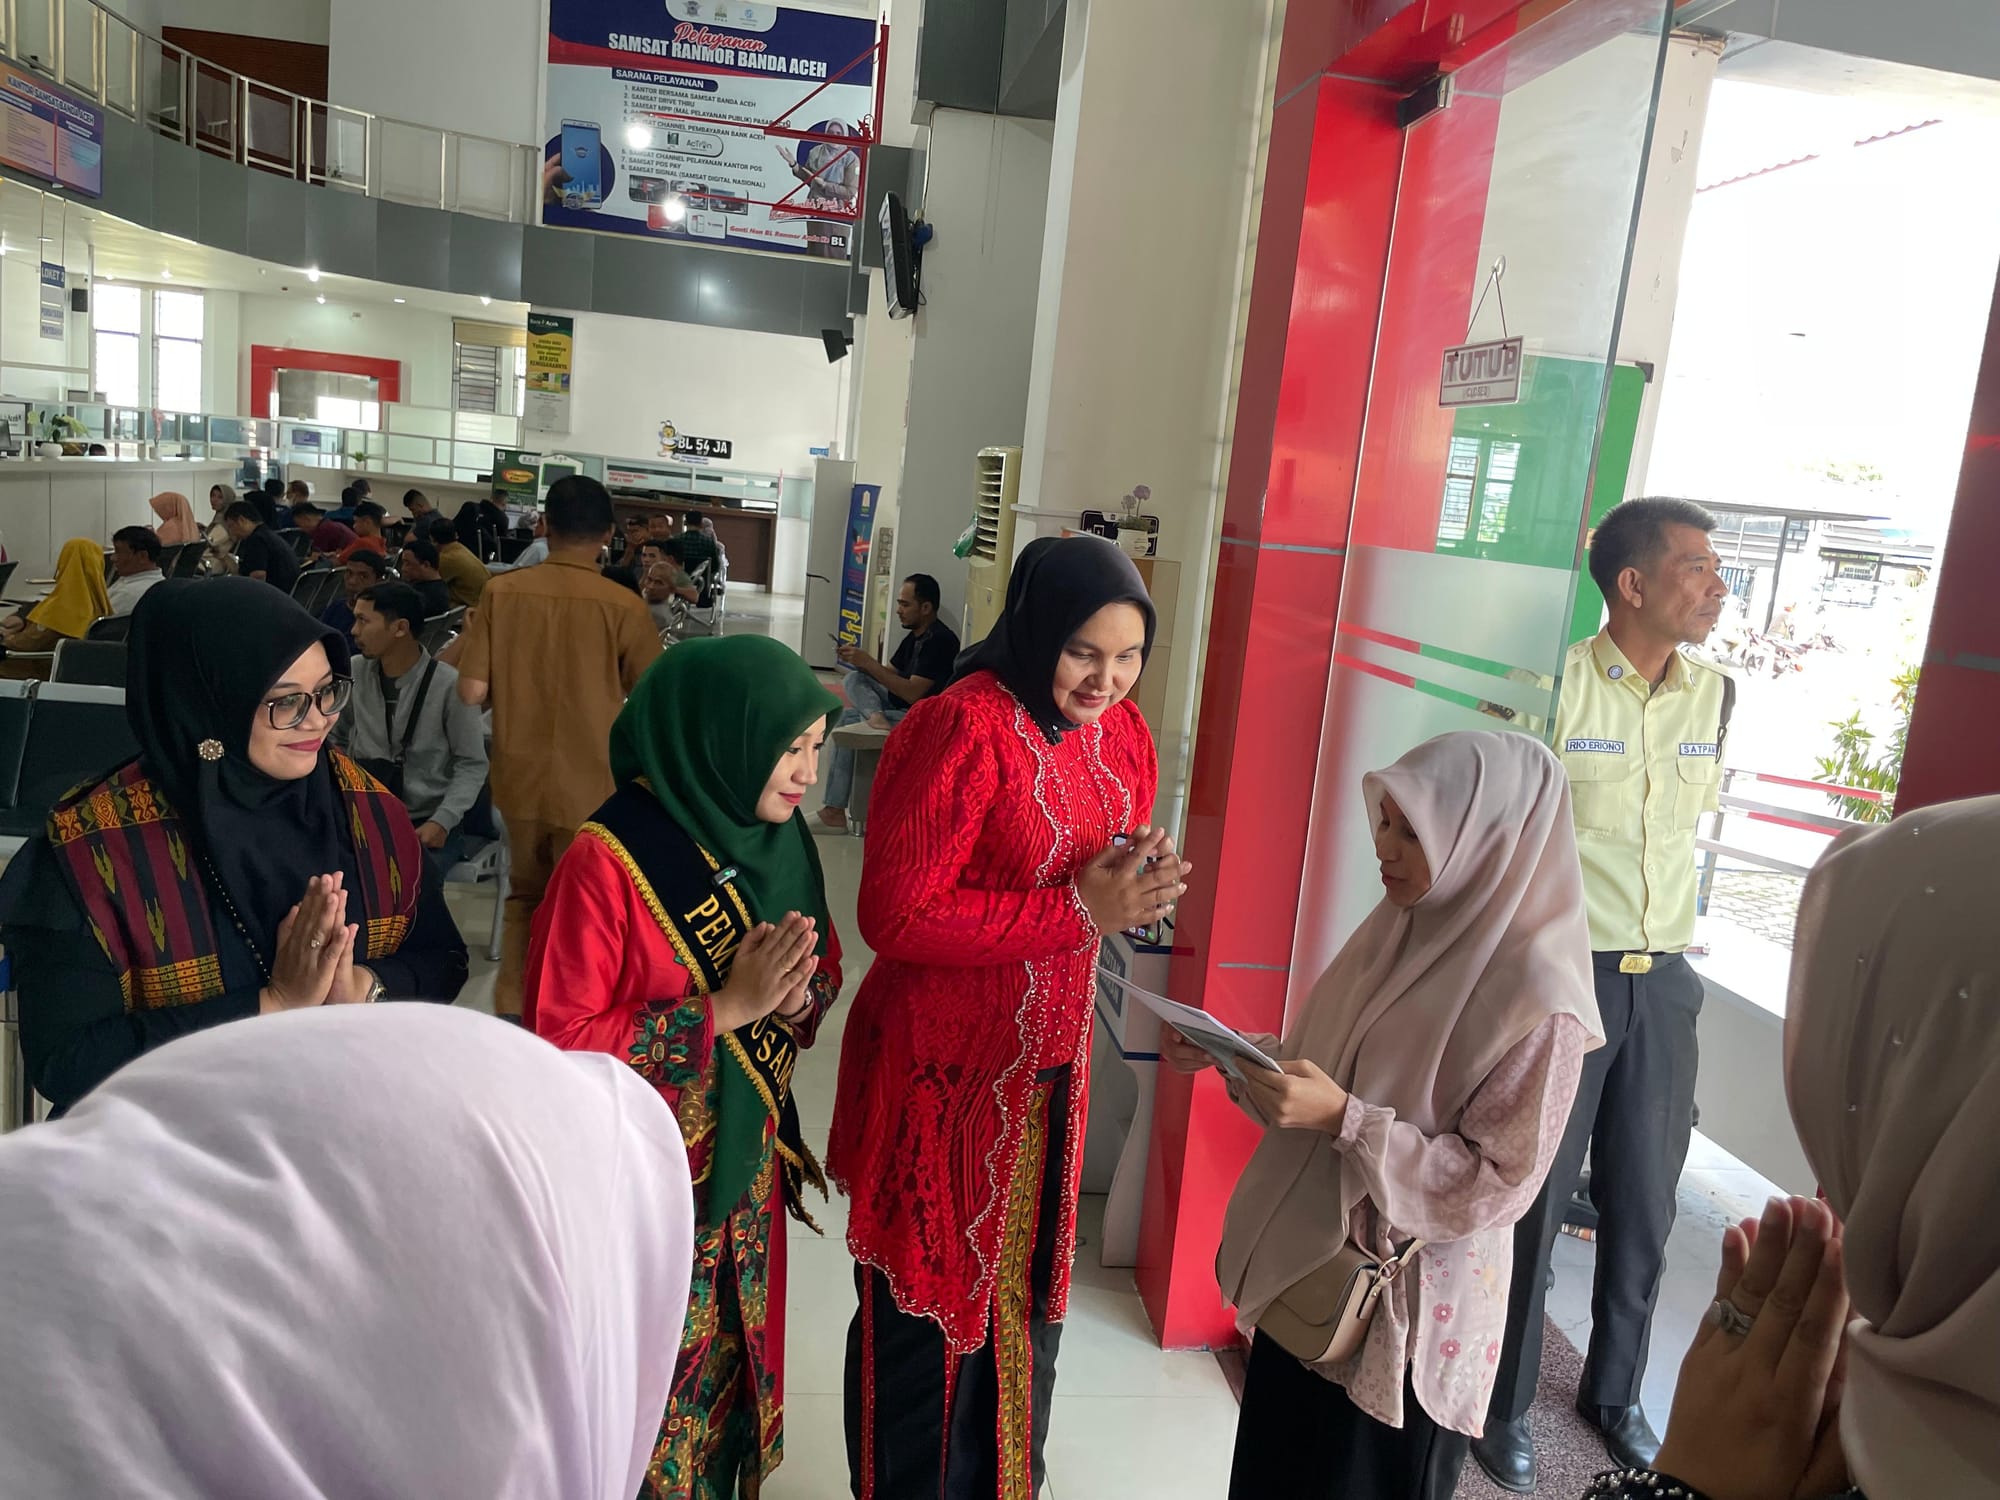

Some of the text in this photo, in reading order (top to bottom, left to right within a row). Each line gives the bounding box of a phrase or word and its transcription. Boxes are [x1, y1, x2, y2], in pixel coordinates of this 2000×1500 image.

[673, 22, 767, 52] Pelayanan
[608, 33, 827, 78] SAMSAT RANMOR BANDA ACEH
[616, 69, 704, 88] SARANA PELAYANAN
[631, 85, 657, 94] KANTOR
[659, 89, 689, 98] BERSAMA
[690, 93, 715, 101] SAMSAT
[717, 97, 738, 105] BANDA
[740, 100, 756, 108] ACEH
[631, 94, 657, 102] SAMSAT
[658, 97, 676, 105] DRIVE
[631, 101, 657, 110] SAMSAT
[691, 110, 727, 120] PELAYANAN
[657, 121, 686, 130] CHANNEL
[688, 124, 729, 136] PEMBAYARAN
[731, 130, 748, 138] BANK
[749, 133, 766, 141] ACEH
[629, 157, 654, 166] SAMSAT
[655, 160, 668, 168] POS
[656, 153, 685, 162] CHANNEL
[686, 157, 722, 167] PELAYANAN
[724, 162, 748, 170] KANTOR
[628, 165, 654, 174] SAMSAT
[655, 169, 678, 177] SIGNAL
[708, 175, 731, 184] DIGITAL
[831, 236, 845, 247] BL
[42, 267, 60, 281] LOKET
[1446, 345, 1518, 382] TUTUP
[678, 437, 693, 450] BL
[696, 439, 710, 452] 54
[713, 441, 728, 454] JA
[1569, 741, 1621, 751] RIO ERIONO
